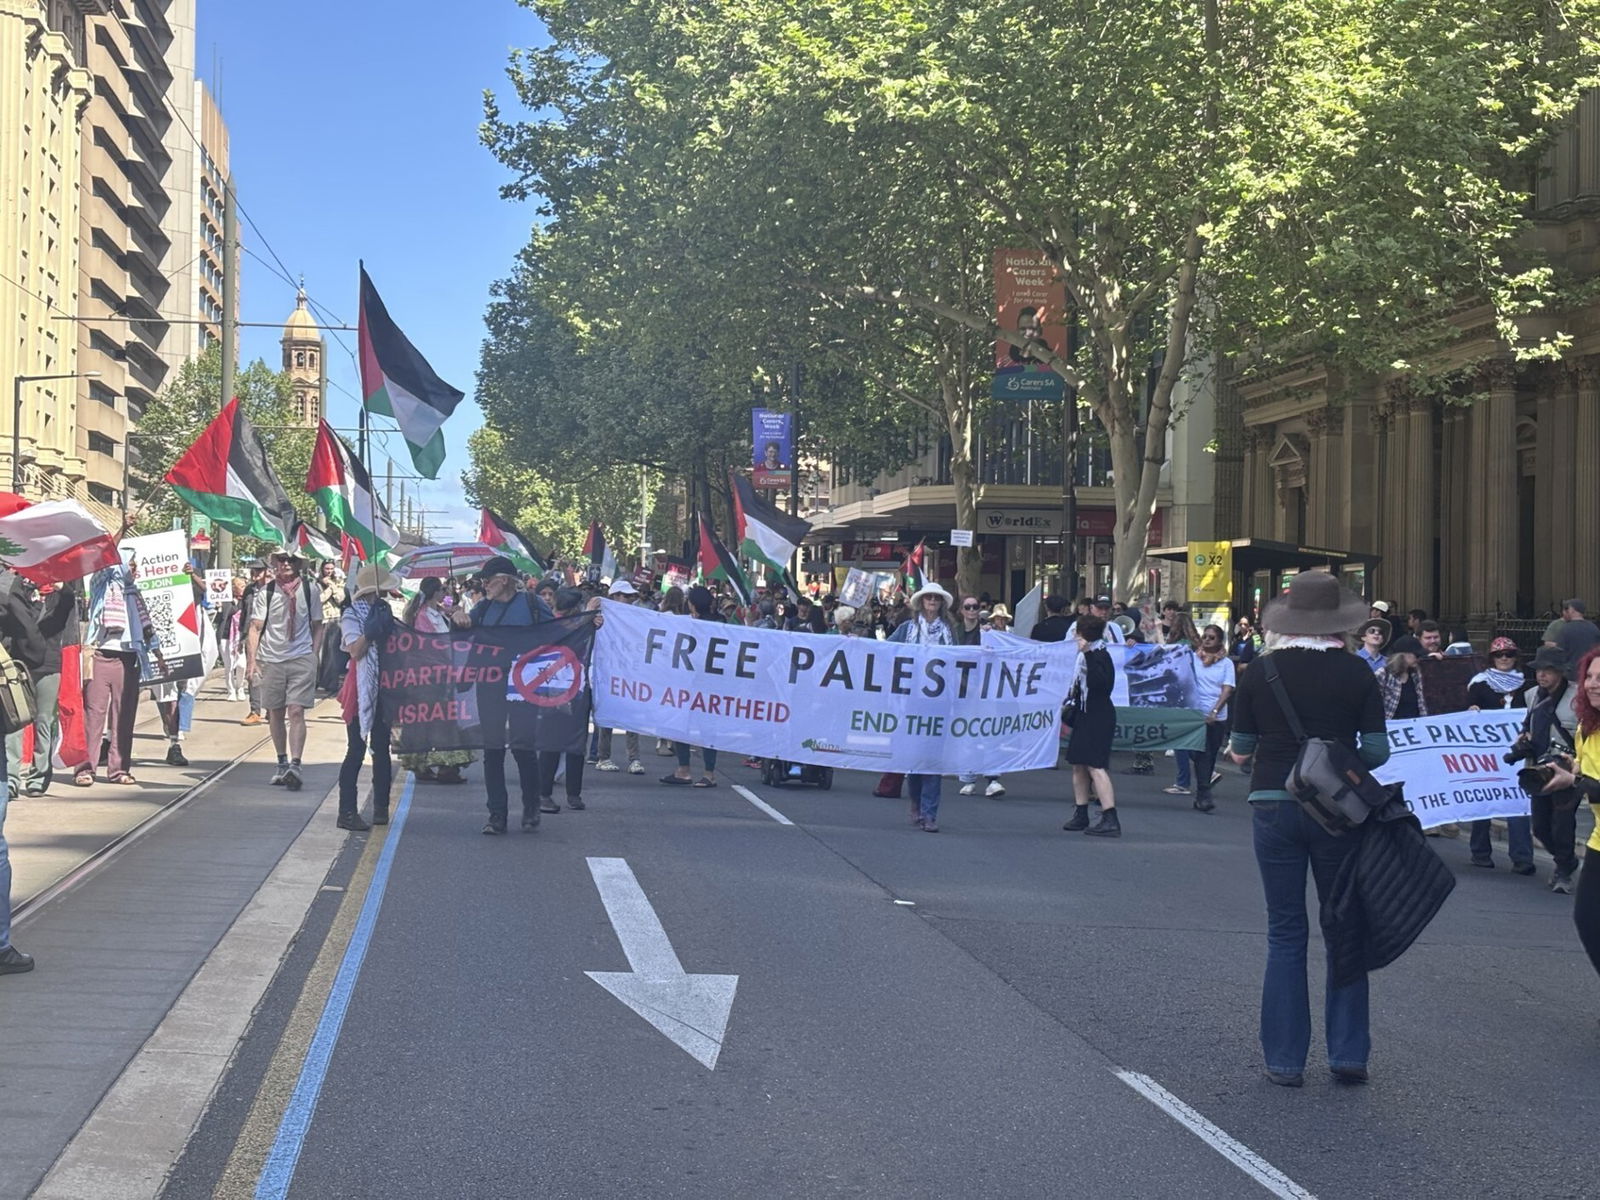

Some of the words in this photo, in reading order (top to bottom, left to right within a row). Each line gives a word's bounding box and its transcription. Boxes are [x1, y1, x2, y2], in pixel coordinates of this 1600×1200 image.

[1006, 257, 1051, 266] Natioal
[1012, 267, 1046, 276] Carers
[1015, 277, 1045, 286] Week
[1020, 378, 1043, 386] Carers
[987, 513, 1051, 527] WorldEx
[141, 553, 179, 566] Action
[1208, 555, 1223, 566] X2
[144, 564, 179, 577] Here
[151, 577, 173, 589] JOIN
[386, 632, 504, 657] BOYCOTT
[644, 628, 760, 679] FREE
[788, 647, 1047, 699] PALESTINE
[380, 665, 503, 690] APARTHEID
[610, 676, 653, 704] END
[660, 687, 791, 724] APARTHEID
[398, 700, 472, 724] ISRAEL
[851, 710, 898, 735] END
[906, 715, 944, 738] THE
[950, 709, 1055, 739] OCCUPATION
[1113, 722, 1169, 744] arget
[1388, 727, 1421, 748] EE
[1442, 754, 1500, 774] NOW
[1418, 792, 1449, 810] THE
